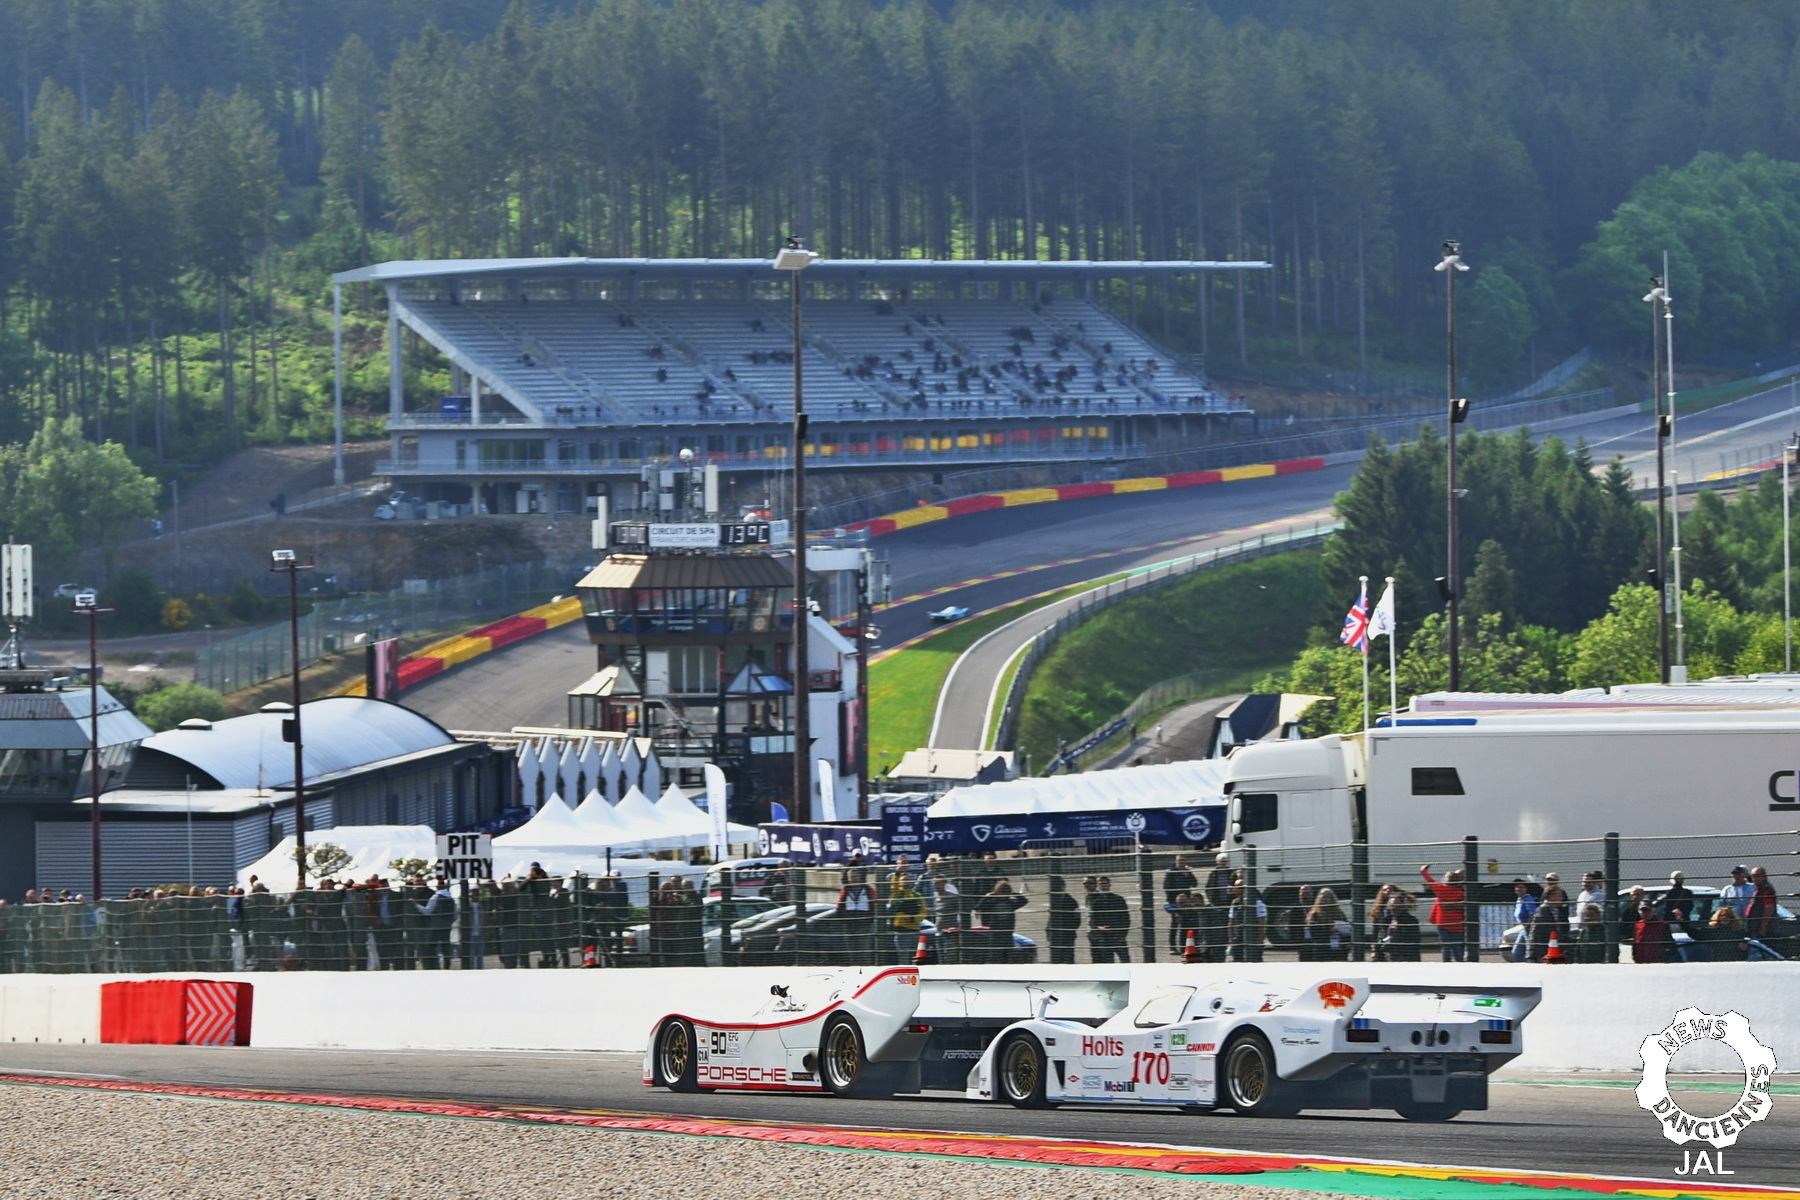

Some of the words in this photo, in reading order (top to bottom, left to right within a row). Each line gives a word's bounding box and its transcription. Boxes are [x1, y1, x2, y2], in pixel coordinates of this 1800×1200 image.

[652, 526, 684, 535] CIRCUIT
[687, 526, 698, 535] DE
[699, 526, 716, 535] SPA
[1769, 770, 1800, 803] C
[448, 835, 480, 855] PIT
[436, 858, 493, 879] ENTRY
[711, 1031, 727, 1054] 90
[1082, 1035, 1125, 1057] Holts
[698, 1066, 787, 1082] PORSCHE
[1131, 1050, 1171, 1086] 170
[1104, 1080, 1127, 1092] Mobil
